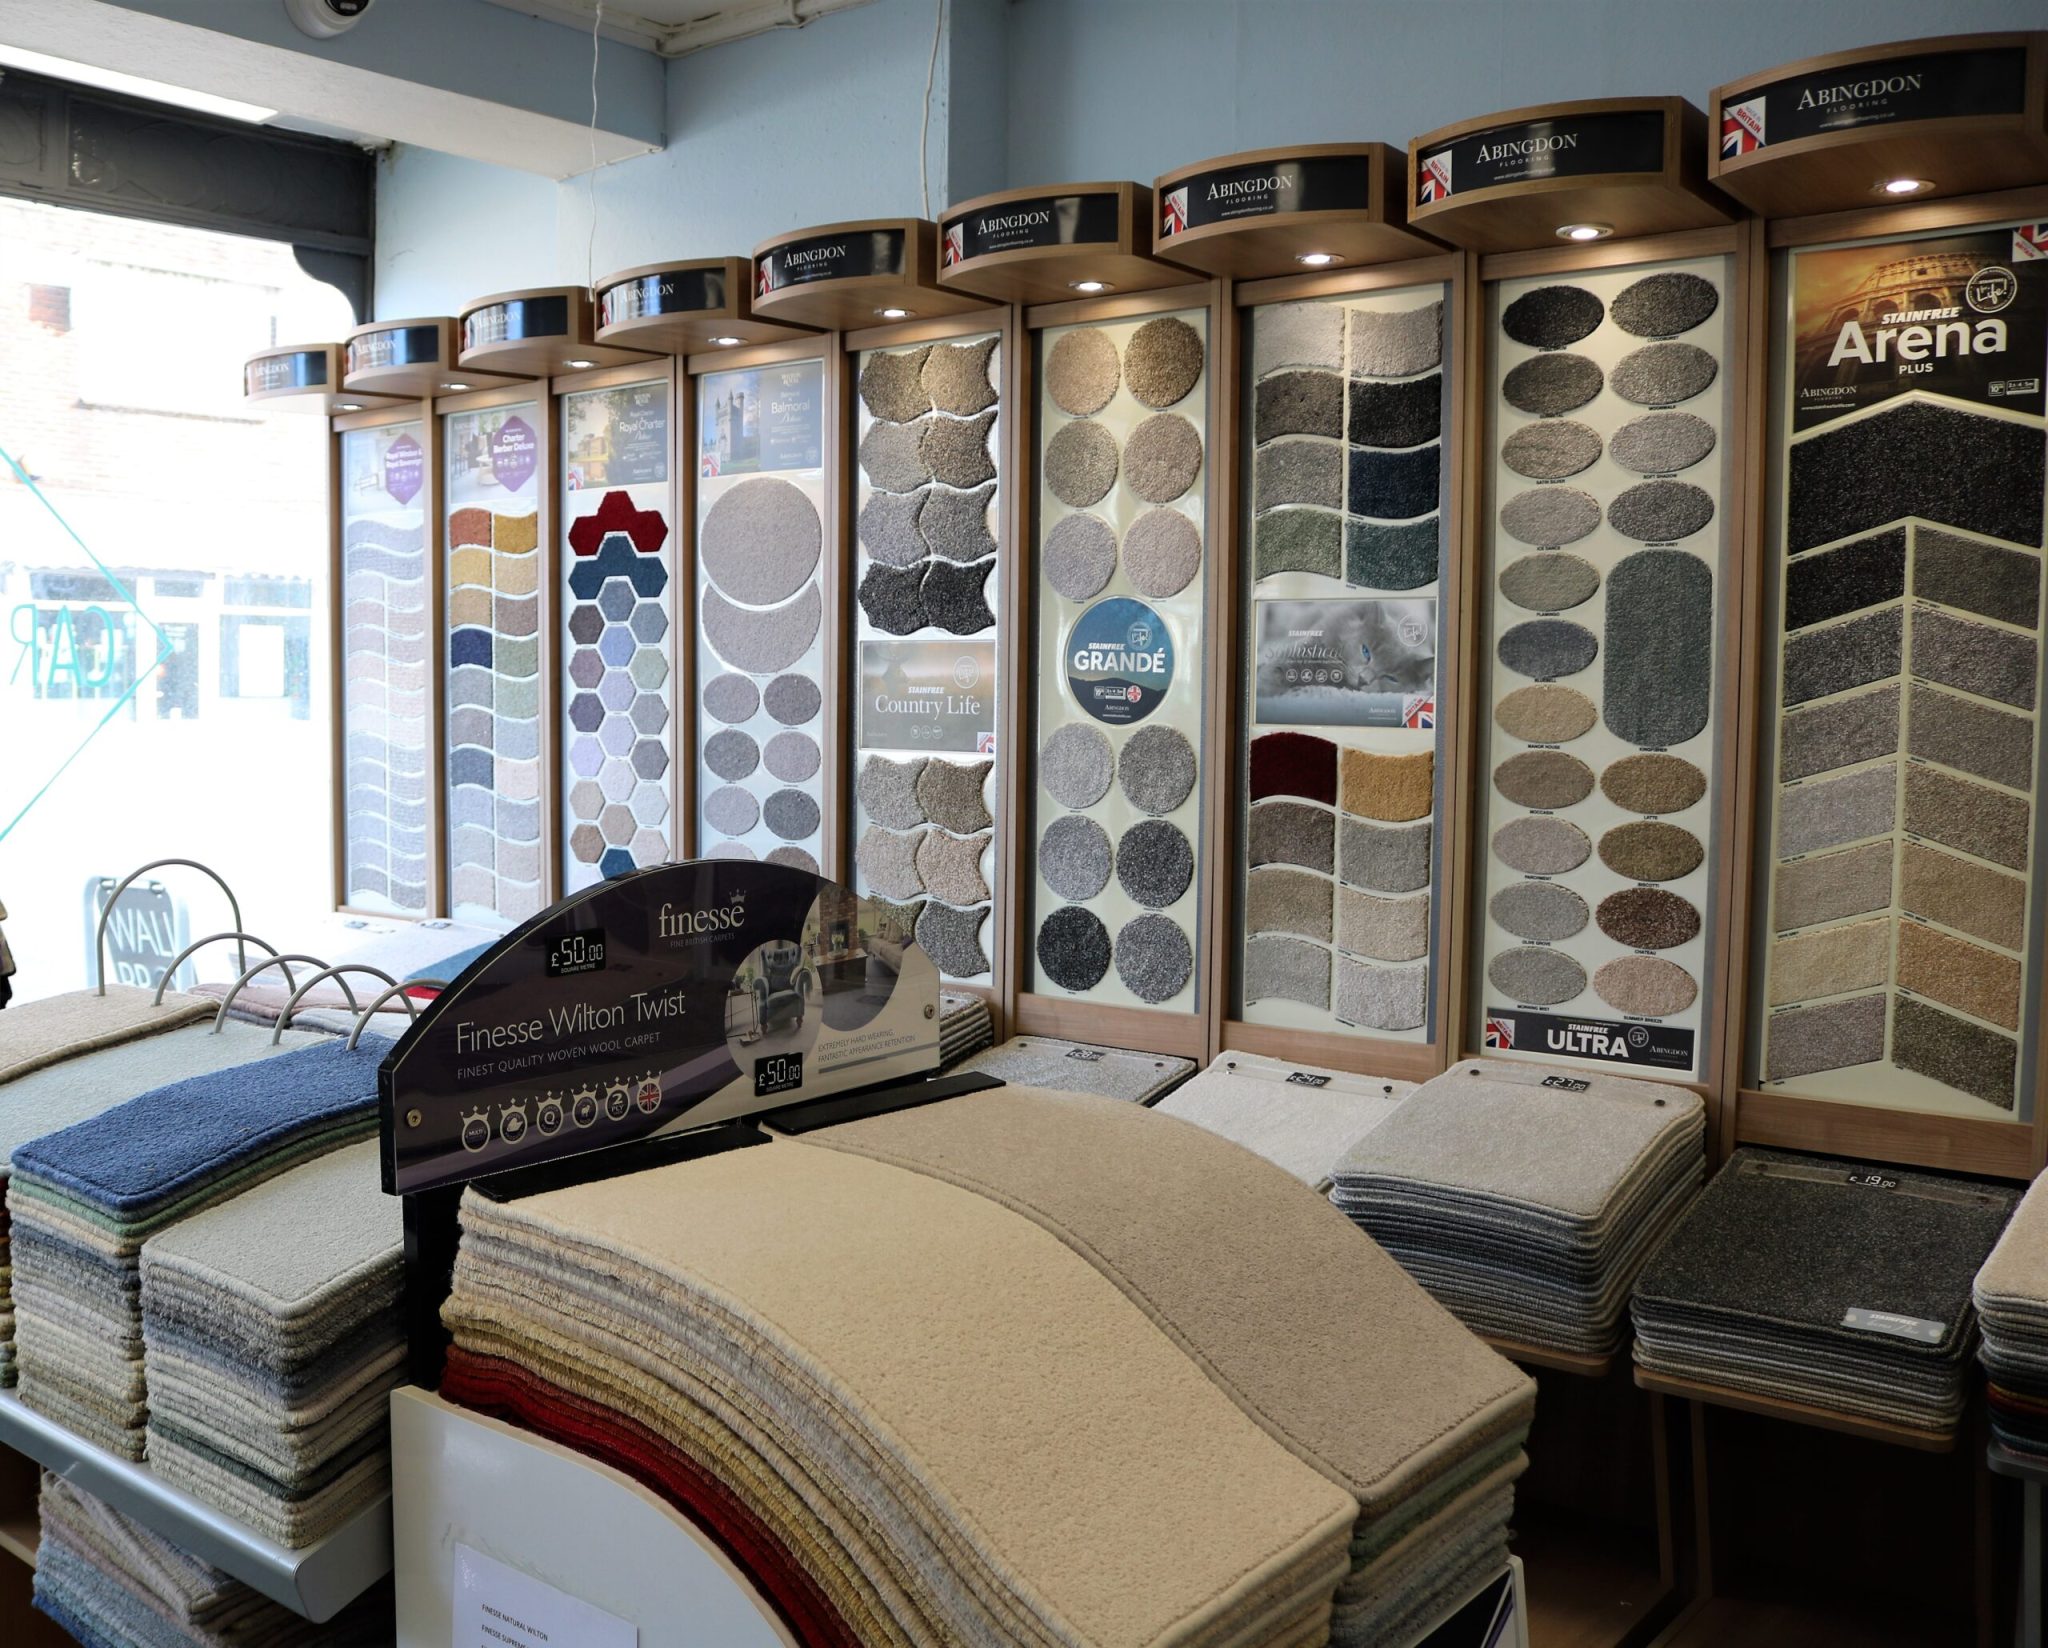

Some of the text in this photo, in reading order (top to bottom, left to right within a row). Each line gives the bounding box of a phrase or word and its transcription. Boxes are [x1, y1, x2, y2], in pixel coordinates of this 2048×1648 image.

[1797, 74, 1923, 111] ABINGDON
[1826, 98, 1888, 114] FLOORING
[1736, 108, 1762, 133] BRITAIN
[1476, 133, 1578, 164] ABINGDON
[1430, 160, 1450, 184] BRITAIN
[1499, 155, 1550, 168] FLOORING
[1207, 175, 1293, 201] ABINGDON
[1226, 193, 1269, 205] FLOORING
[977, 210, 1050, 235] ABINGDON
[992, 228, 1029, 238] FLOORING
[784, 245, 847, 268] ABINGDON
[1881, 306, 1960, 325] STAINFREE
[1827, 318, 2008, 367] Arena
[1899, 363, 1934, 375] PLUS
[1800, 386, 1857, 398] ABINGDON
[771, 398, 811, 414] Balmoral
[502, 433, 526, 443] Charter
[619, 420, 638, 434] Royal
[1074, 648, 1166, 673] GRANDÉ
[875, 695, 981, 721] Country Life
[659, 903, 745, 938] finesse
[551, 936, 603, 967] £50.00
[457, 988, 686, 1054] Finesse Wilton Twist
[1568, 1023, 1609, 1034] STAINFREE
[818, 1039, 850, 1052] EXTREMELY
[851, 1036, 867, 1045] HARD
[818, 1034, 916, 1063] FANTASTIC APPEARANCE RETENTION
[1547, 1028, 1630, 1058] ULTRA
[1649, 1045, 1688, 1056] ABINGDON
[457, 1031, 661, 1080] FINEST QUALITY WOVEN WOOL CARPET
[759, 1058, 801, 1087] £50.00
[611, 1104, 624, 1113] PLY
[612, 1093, 623, 1105] 2
[481, 1603, 548, 1641] FINESSE NATURAL WILTON
[481, 1624, 501, 1640] FINESSE
